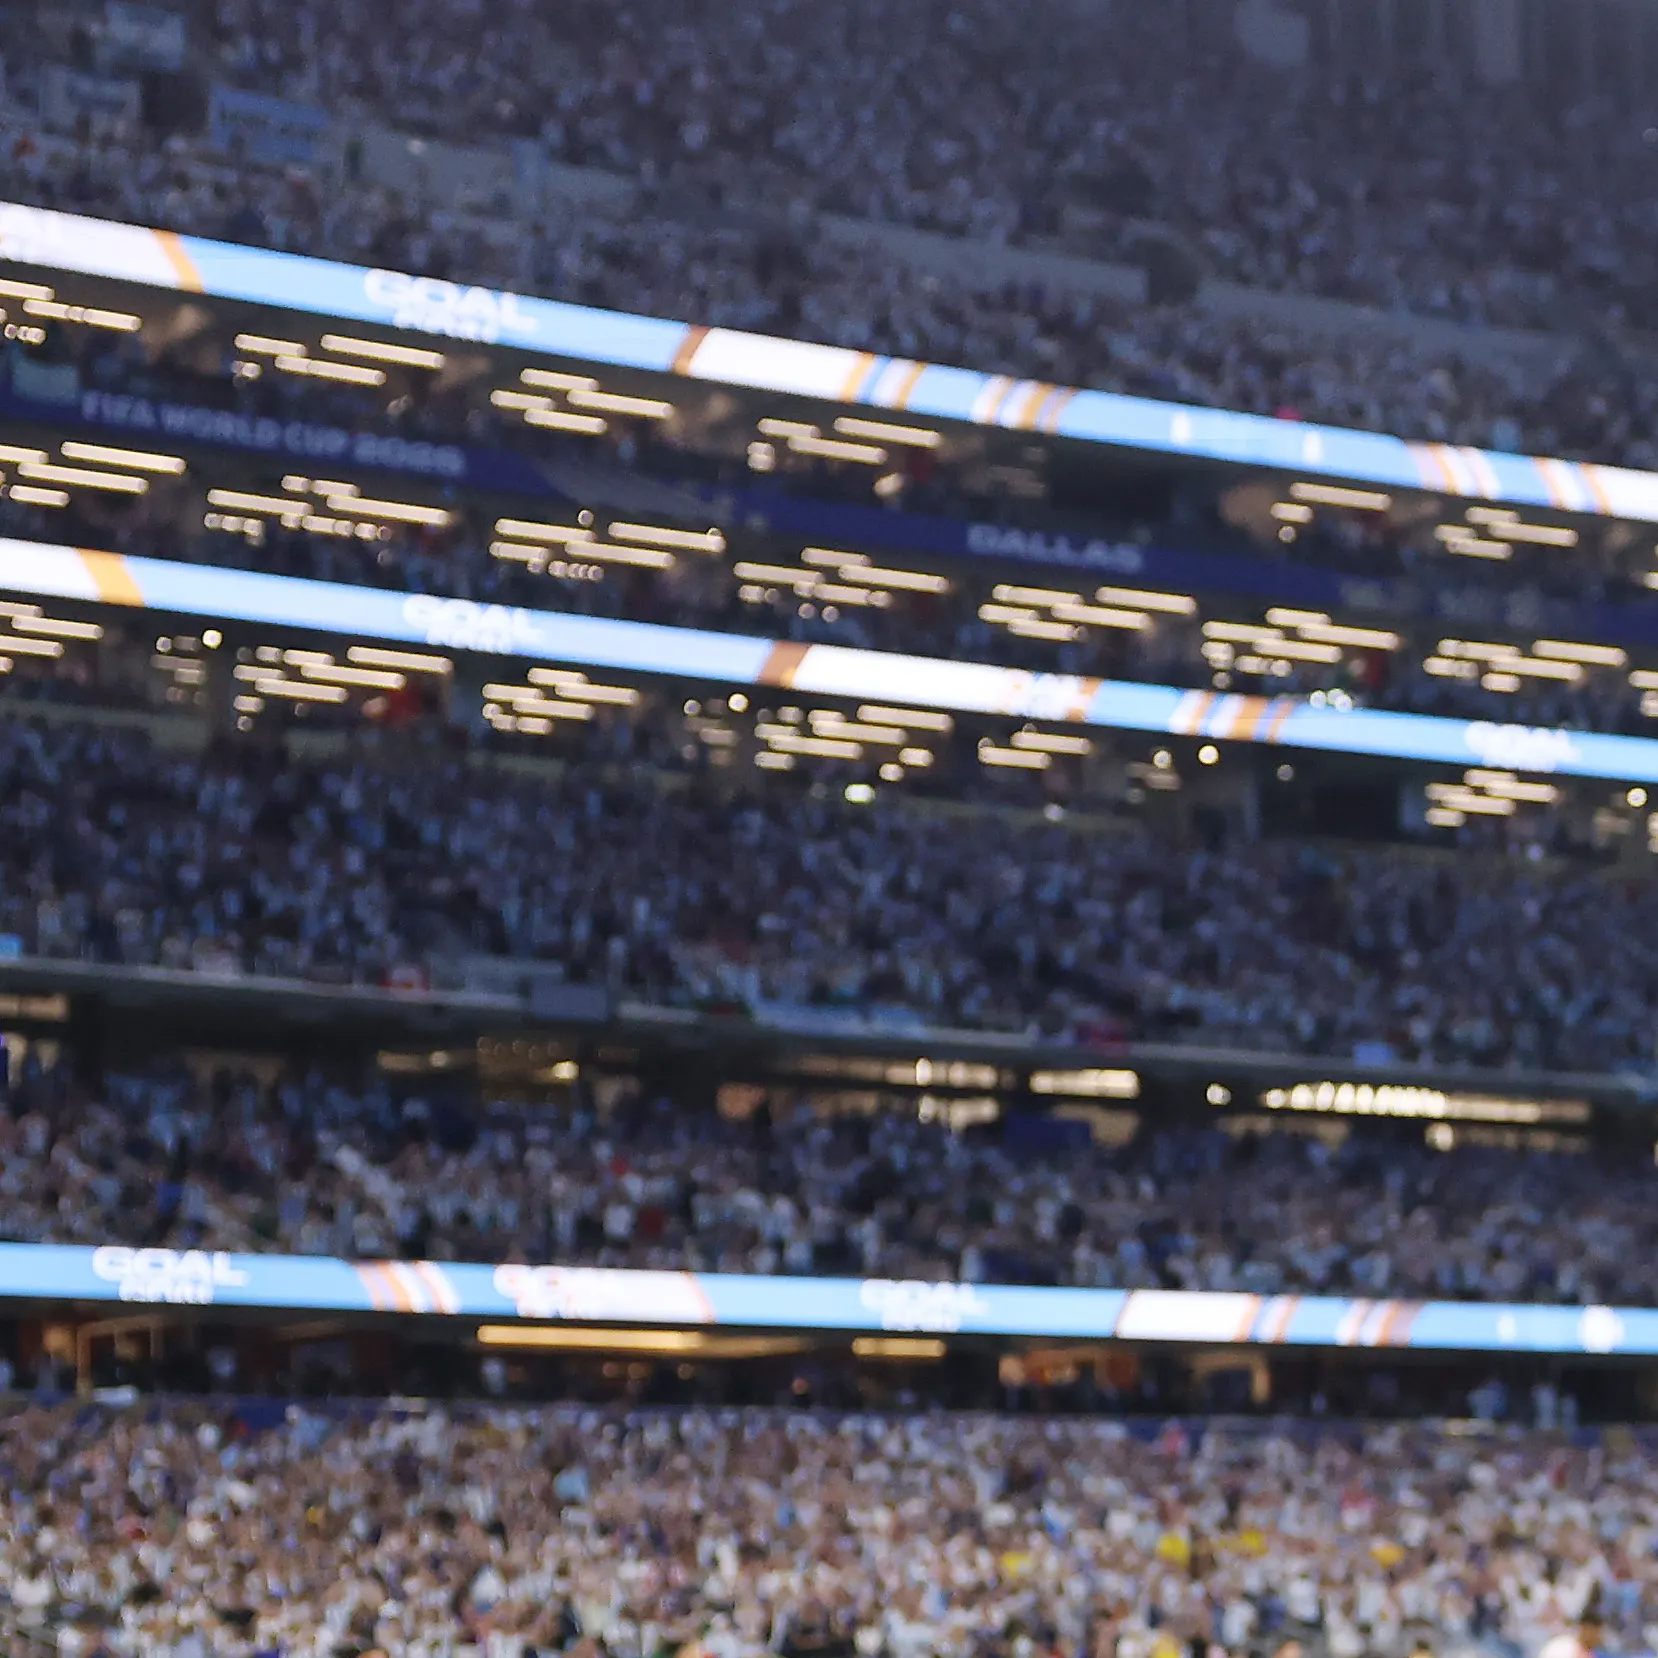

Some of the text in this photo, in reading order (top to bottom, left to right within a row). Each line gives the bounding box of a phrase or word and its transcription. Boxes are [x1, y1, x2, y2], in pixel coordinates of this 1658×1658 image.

[365, 268, 539, 332] GOAL
[81, 390, 157, 429] FIFA
[161, 402, 281, 449] WORLD
[285, 421, 350, 457] CUP
[966, 523, 1145, 574] DALLAS
[403, 593, 545, 642] GOAL
[92, 1246, 251, 1288] GOAL
